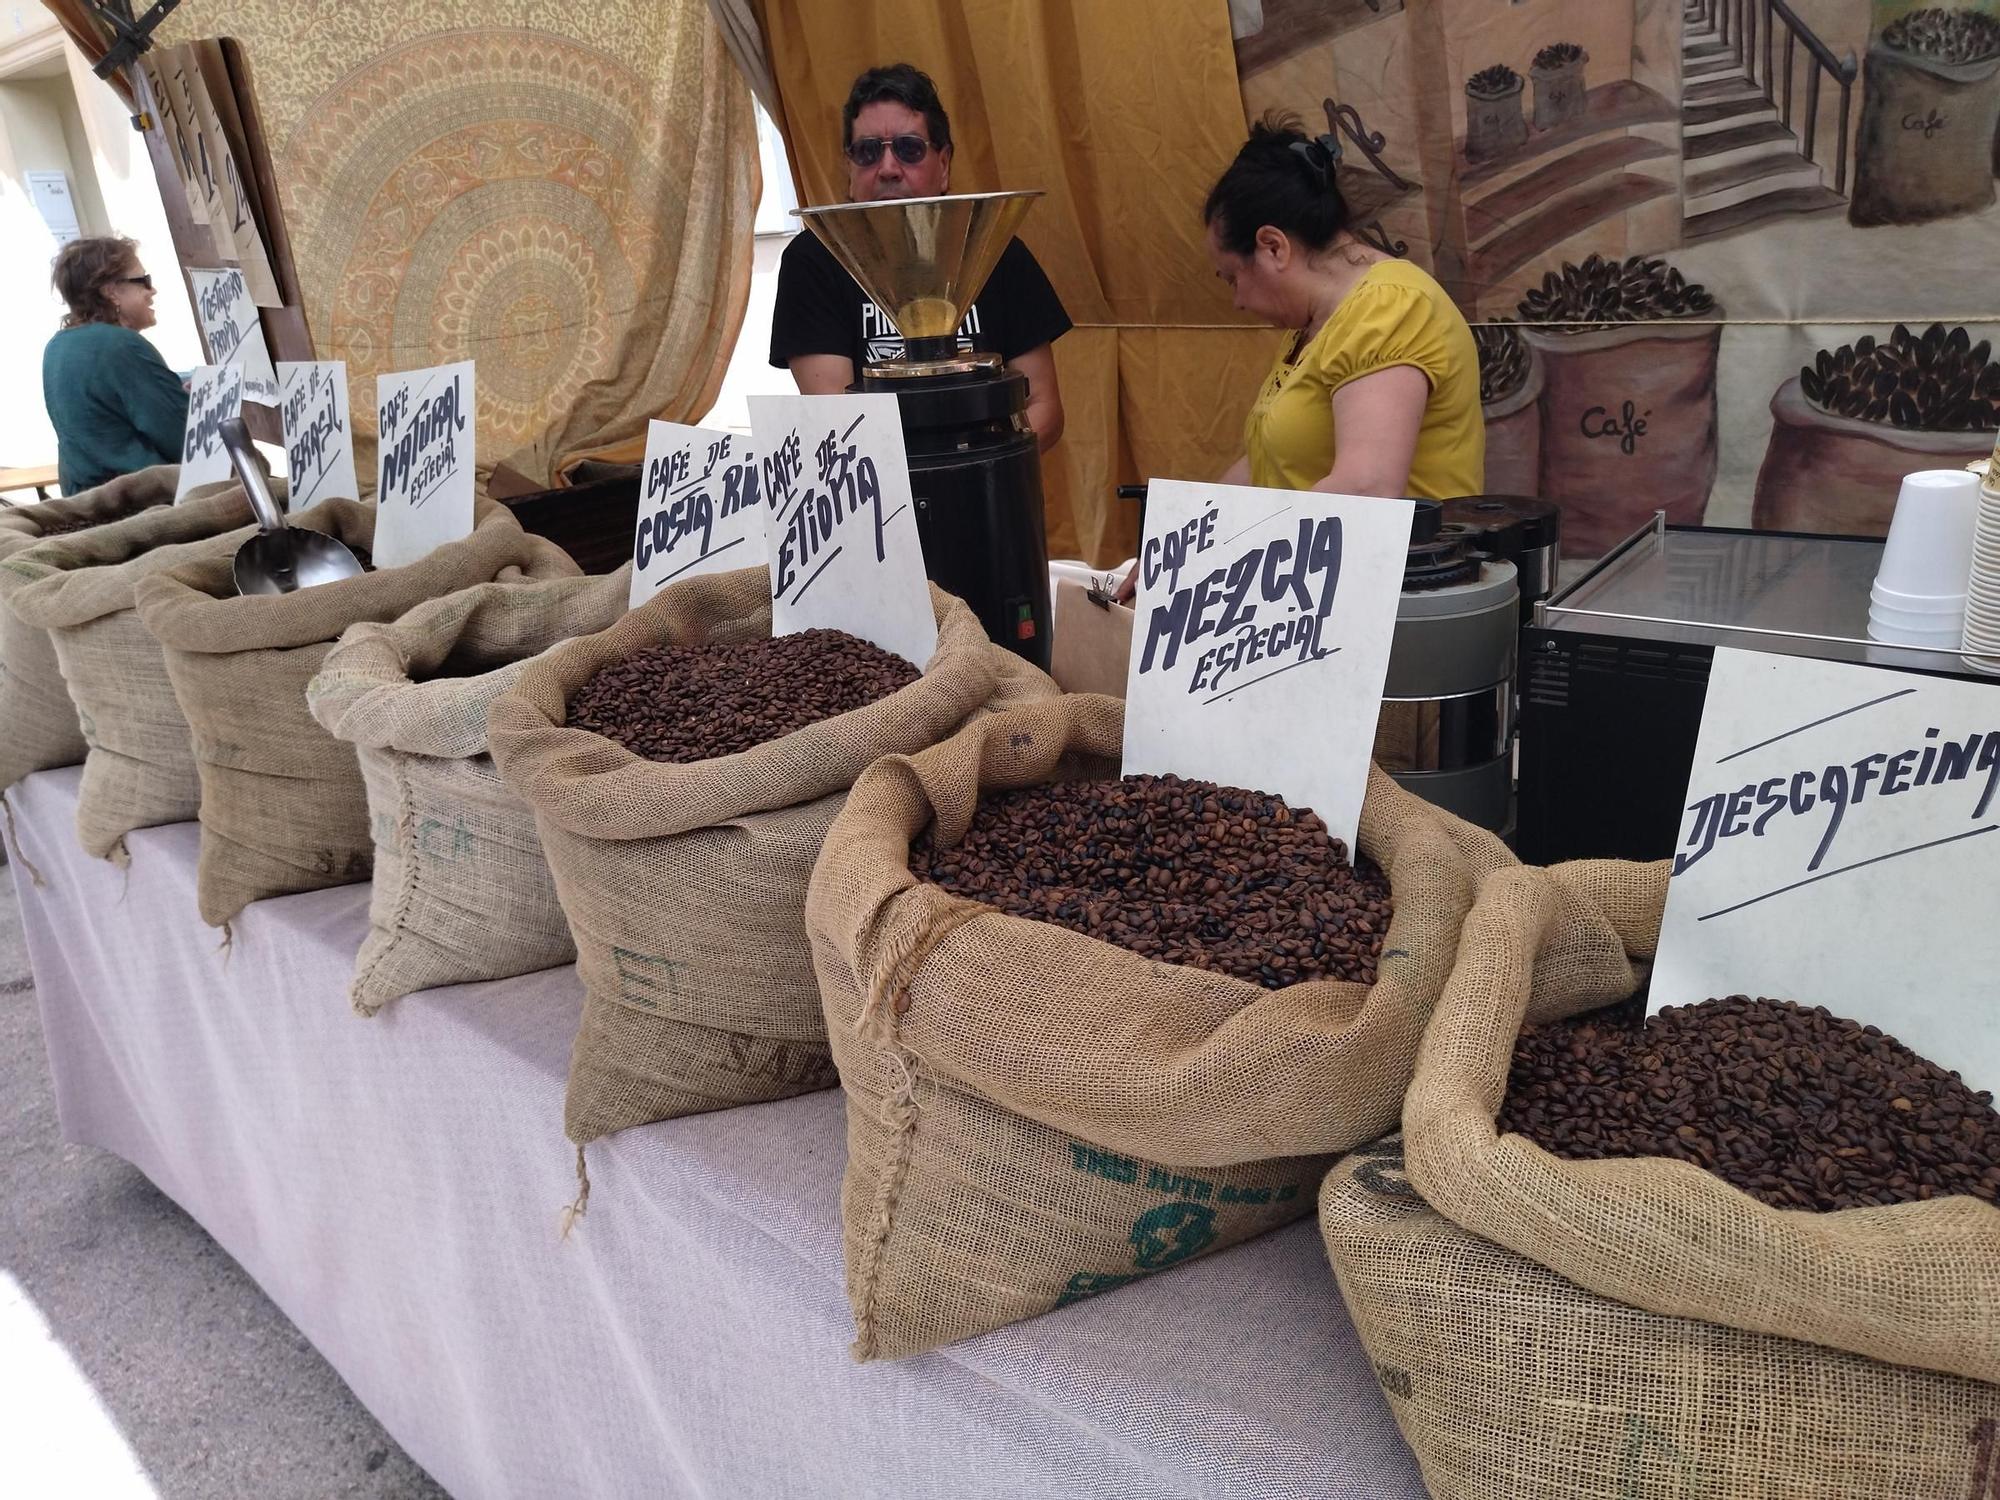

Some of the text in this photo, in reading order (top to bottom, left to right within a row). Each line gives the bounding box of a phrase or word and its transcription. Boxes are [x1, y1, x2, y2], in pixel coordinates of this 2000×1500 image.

[208, 320, 240, 364] PROPIO
[380, 374, 466, 503] NATURAL
[648, 434, 732, 504] CAFÉ DE
[763, 427, 838, 510] CAFÉ DE
[1580, 400, 1652, 455] Café
[636, 487, 713, 571] COSTA
[1143, 500, 1219, 595] CAFÉ
[1139, 516, 1343, 674] MEZCLA
